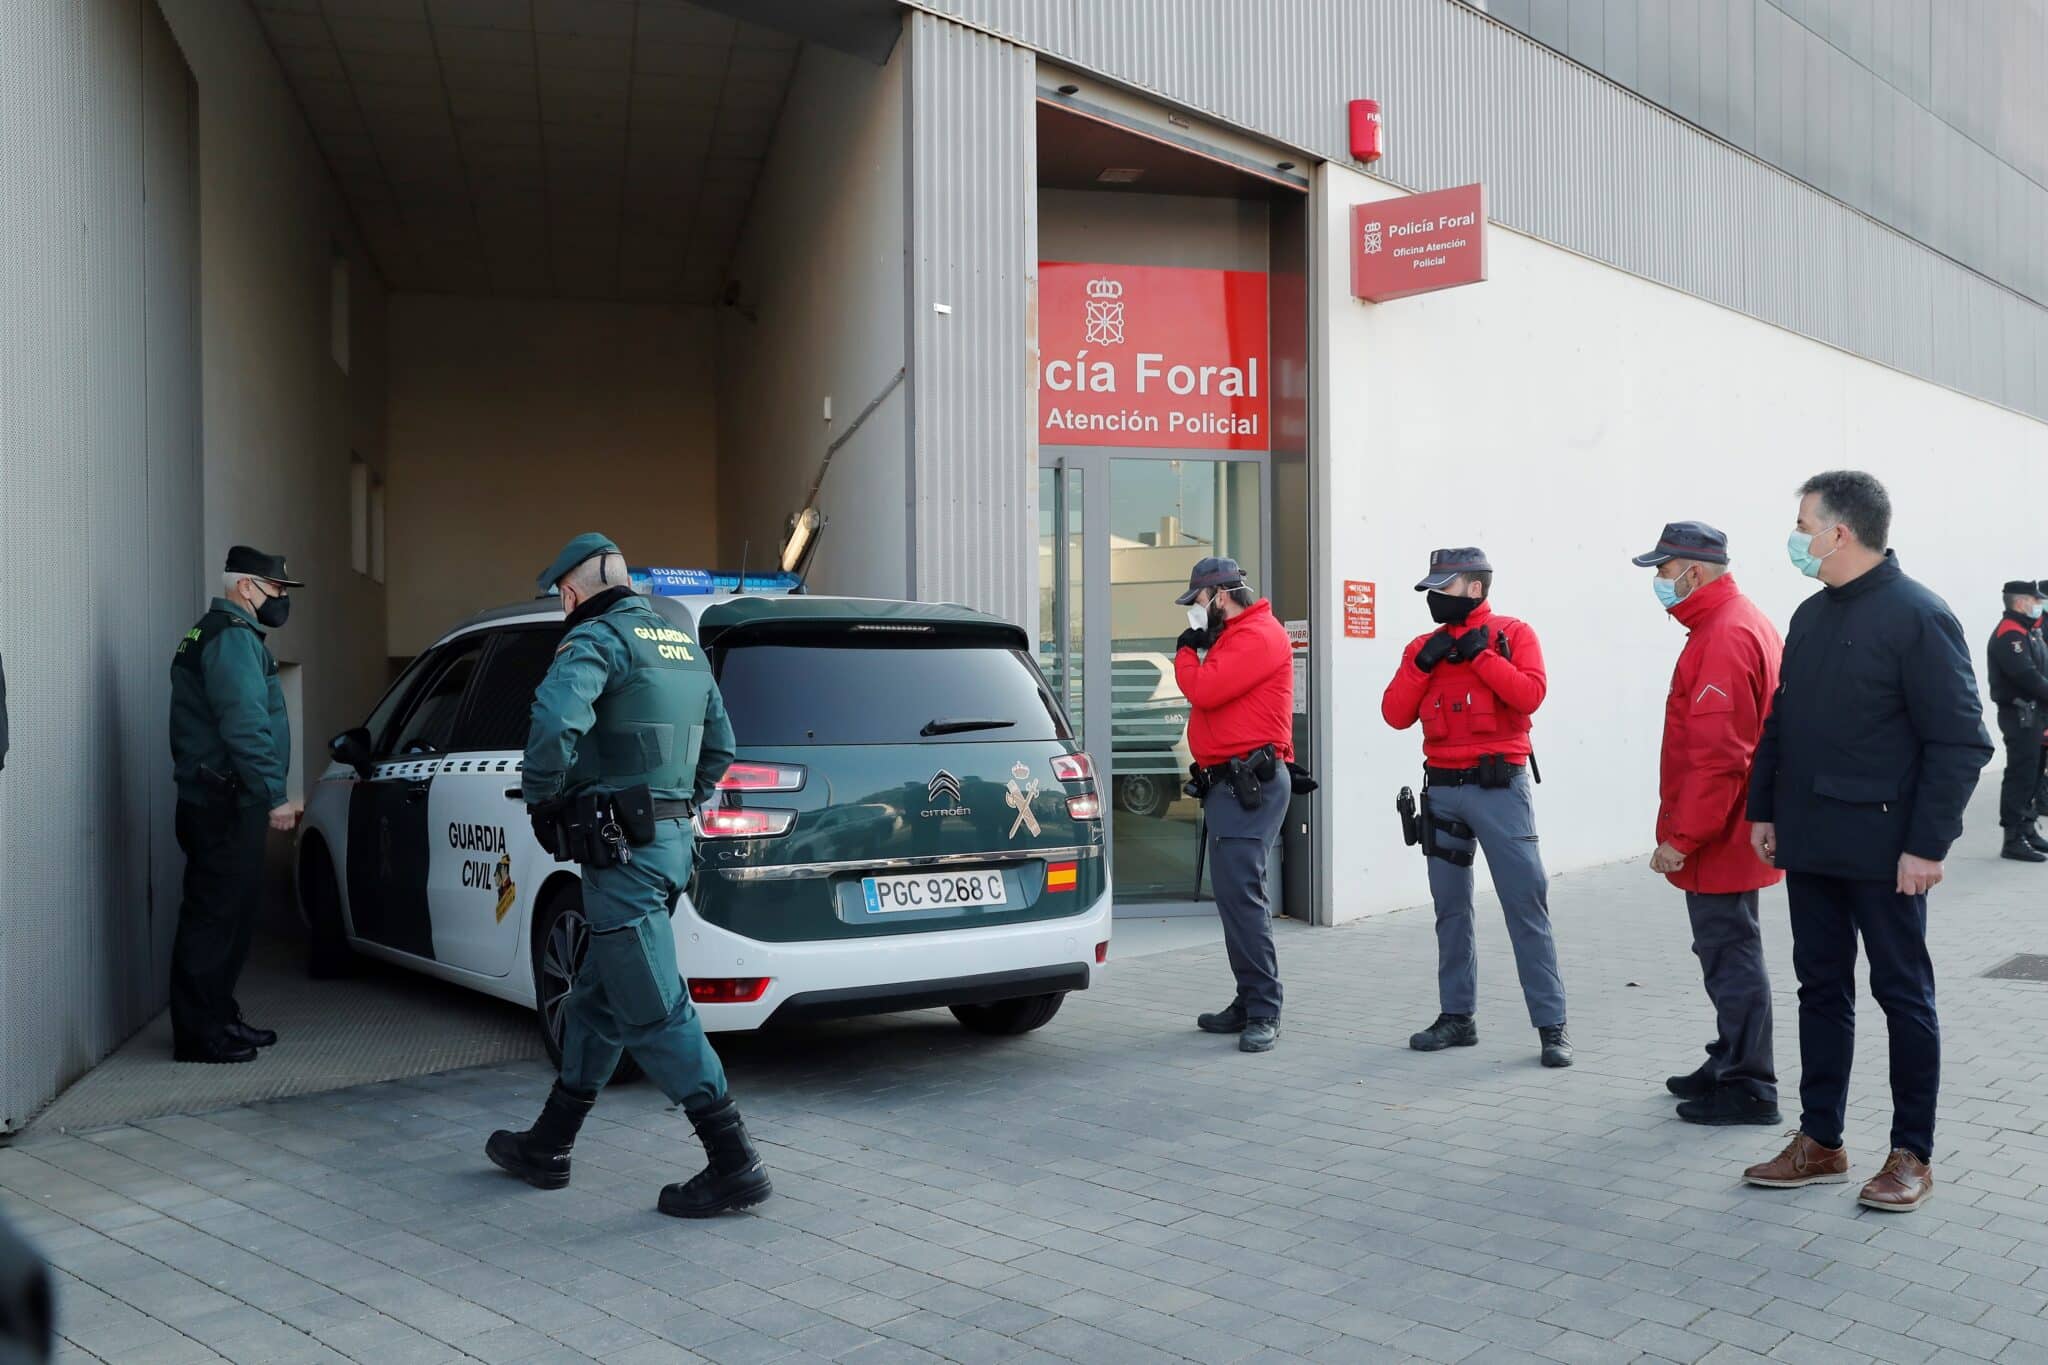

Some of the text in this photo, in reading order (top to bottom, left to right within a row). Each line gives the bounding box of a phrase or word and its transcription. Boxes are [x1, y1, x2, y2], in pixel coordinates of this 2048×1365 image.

[1389, 211, 1475, 238] Policía Foral
[1393, 238, 1466, 257] Oficina Atención
[1413, 256, 1446, 269] Policial
[1038, 350, 1257, 398] cía Foral
[1045, 407, 1258, 435] Atención Policial
[652, 568, 706, 577] GUARDIA
[666, 576, 699, 585] CIVIL
[634, 627, 695, 644] GUARDIA
[658, 644, 694, 660] CIVIL
[448, 822, 506, 854] GUARDIA
[462, 860, 491, 890] CIVIL
[877, 880, 923, 908] PGC
[927, 876, 983, 904] 9268
[987, 875, 1001, 899] C
